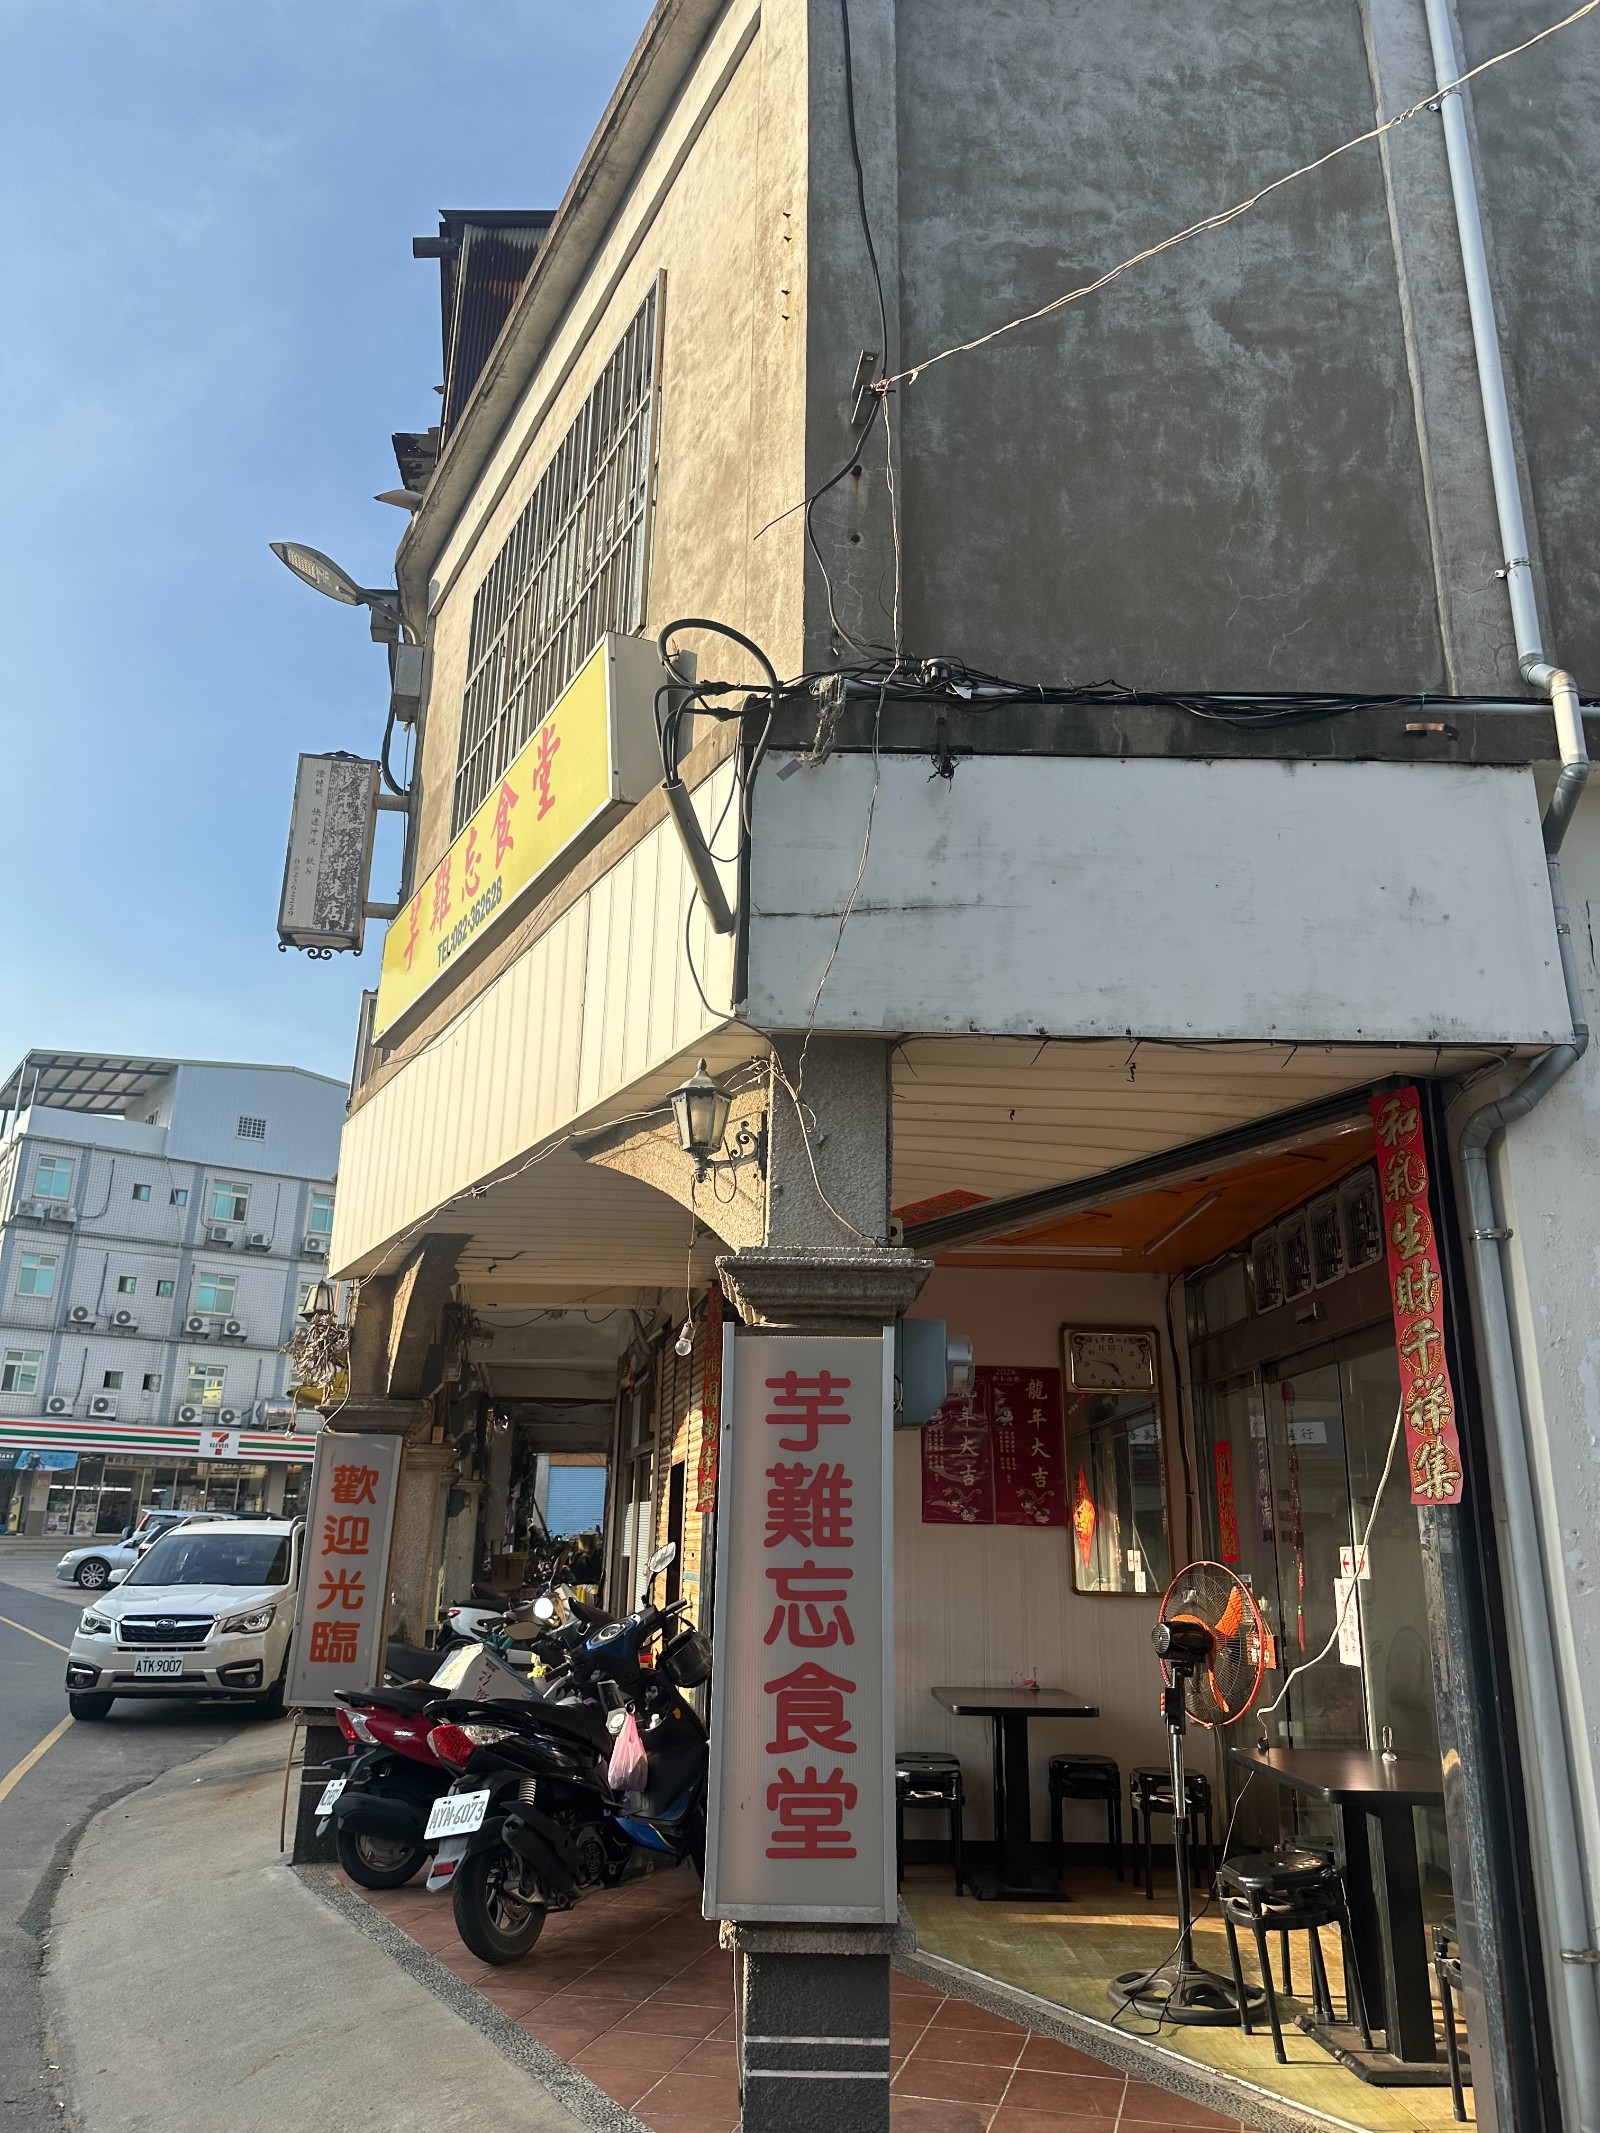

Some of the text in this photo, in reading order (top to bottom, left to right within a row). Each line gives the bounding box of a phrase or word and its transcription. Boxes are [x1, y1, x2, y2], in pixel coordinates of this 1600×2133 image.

[403, 723, 561, 972] 芋難忘食堂
[995, 1367, 1016, 1376] 2024
[1377, 1094, 1462, 1502] 和氣生財千祥集
[1025, 1378, 1051, 1489] 龍年大吉
[309, 1463, 379, 1664] 歡迎光臨
[763, 1368, 858, 1860] 芋難忘食堂
[134, 1659, 183, 1674] ATK-9007
